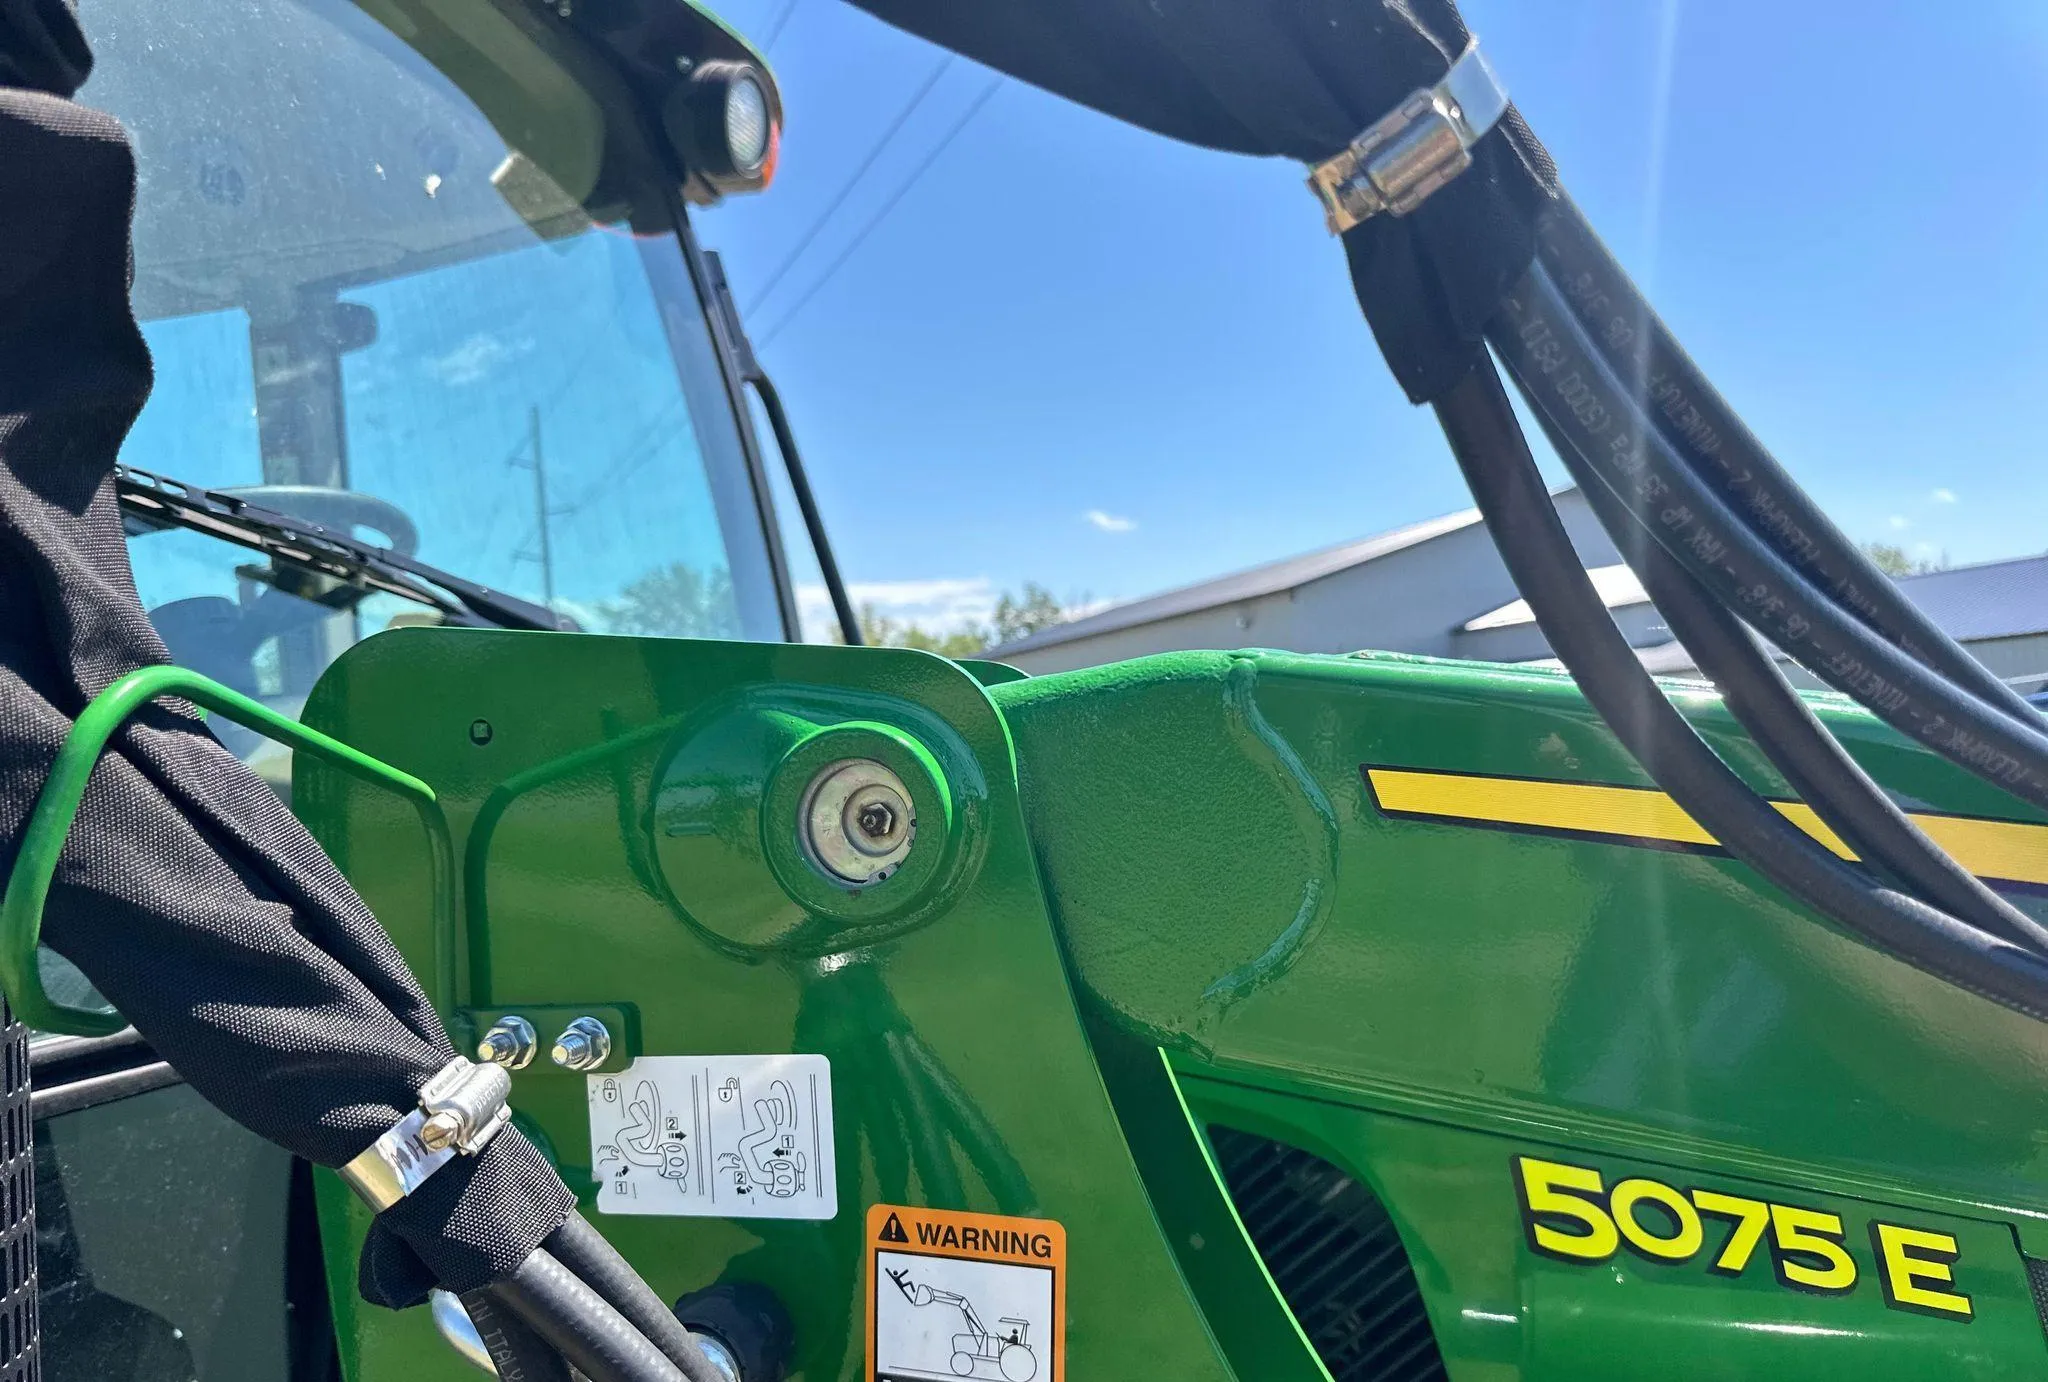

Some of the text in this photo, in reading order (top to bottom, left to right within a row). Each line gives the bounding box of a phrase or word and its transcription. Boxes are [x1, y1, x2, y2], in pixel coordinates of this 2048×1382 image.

[916, 1221, 1053, 1259] WARNING
[1515, 1155, 1974, 1320] 5075 E
[467, 1297, 525, 1382] IN ITALY
